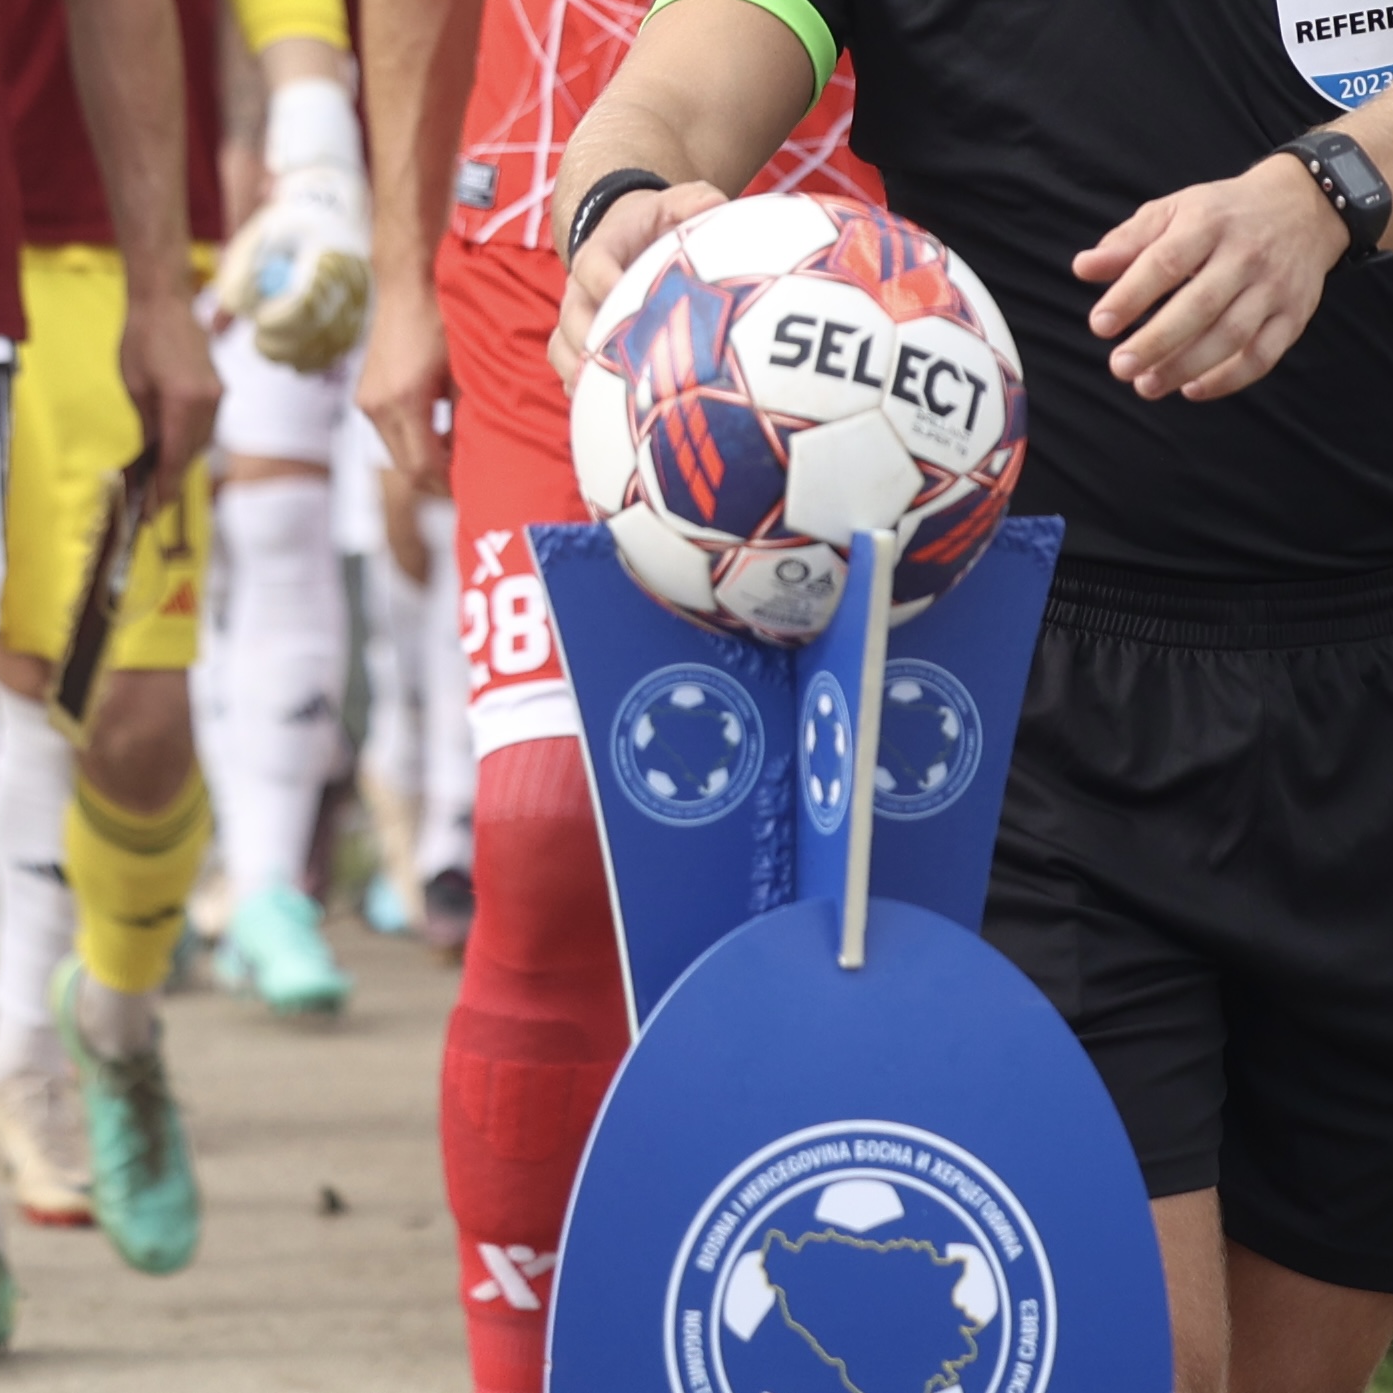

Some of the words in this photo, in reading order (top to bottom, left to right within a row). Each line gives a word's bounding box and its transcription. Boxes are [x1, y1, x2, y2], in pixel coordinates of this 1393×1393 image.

[768, 314, 988, 433] SELECT
[695, 1210, 740, 1273] BOSNA
[738, 1139, 853, 1210] HERCEGOVINA
